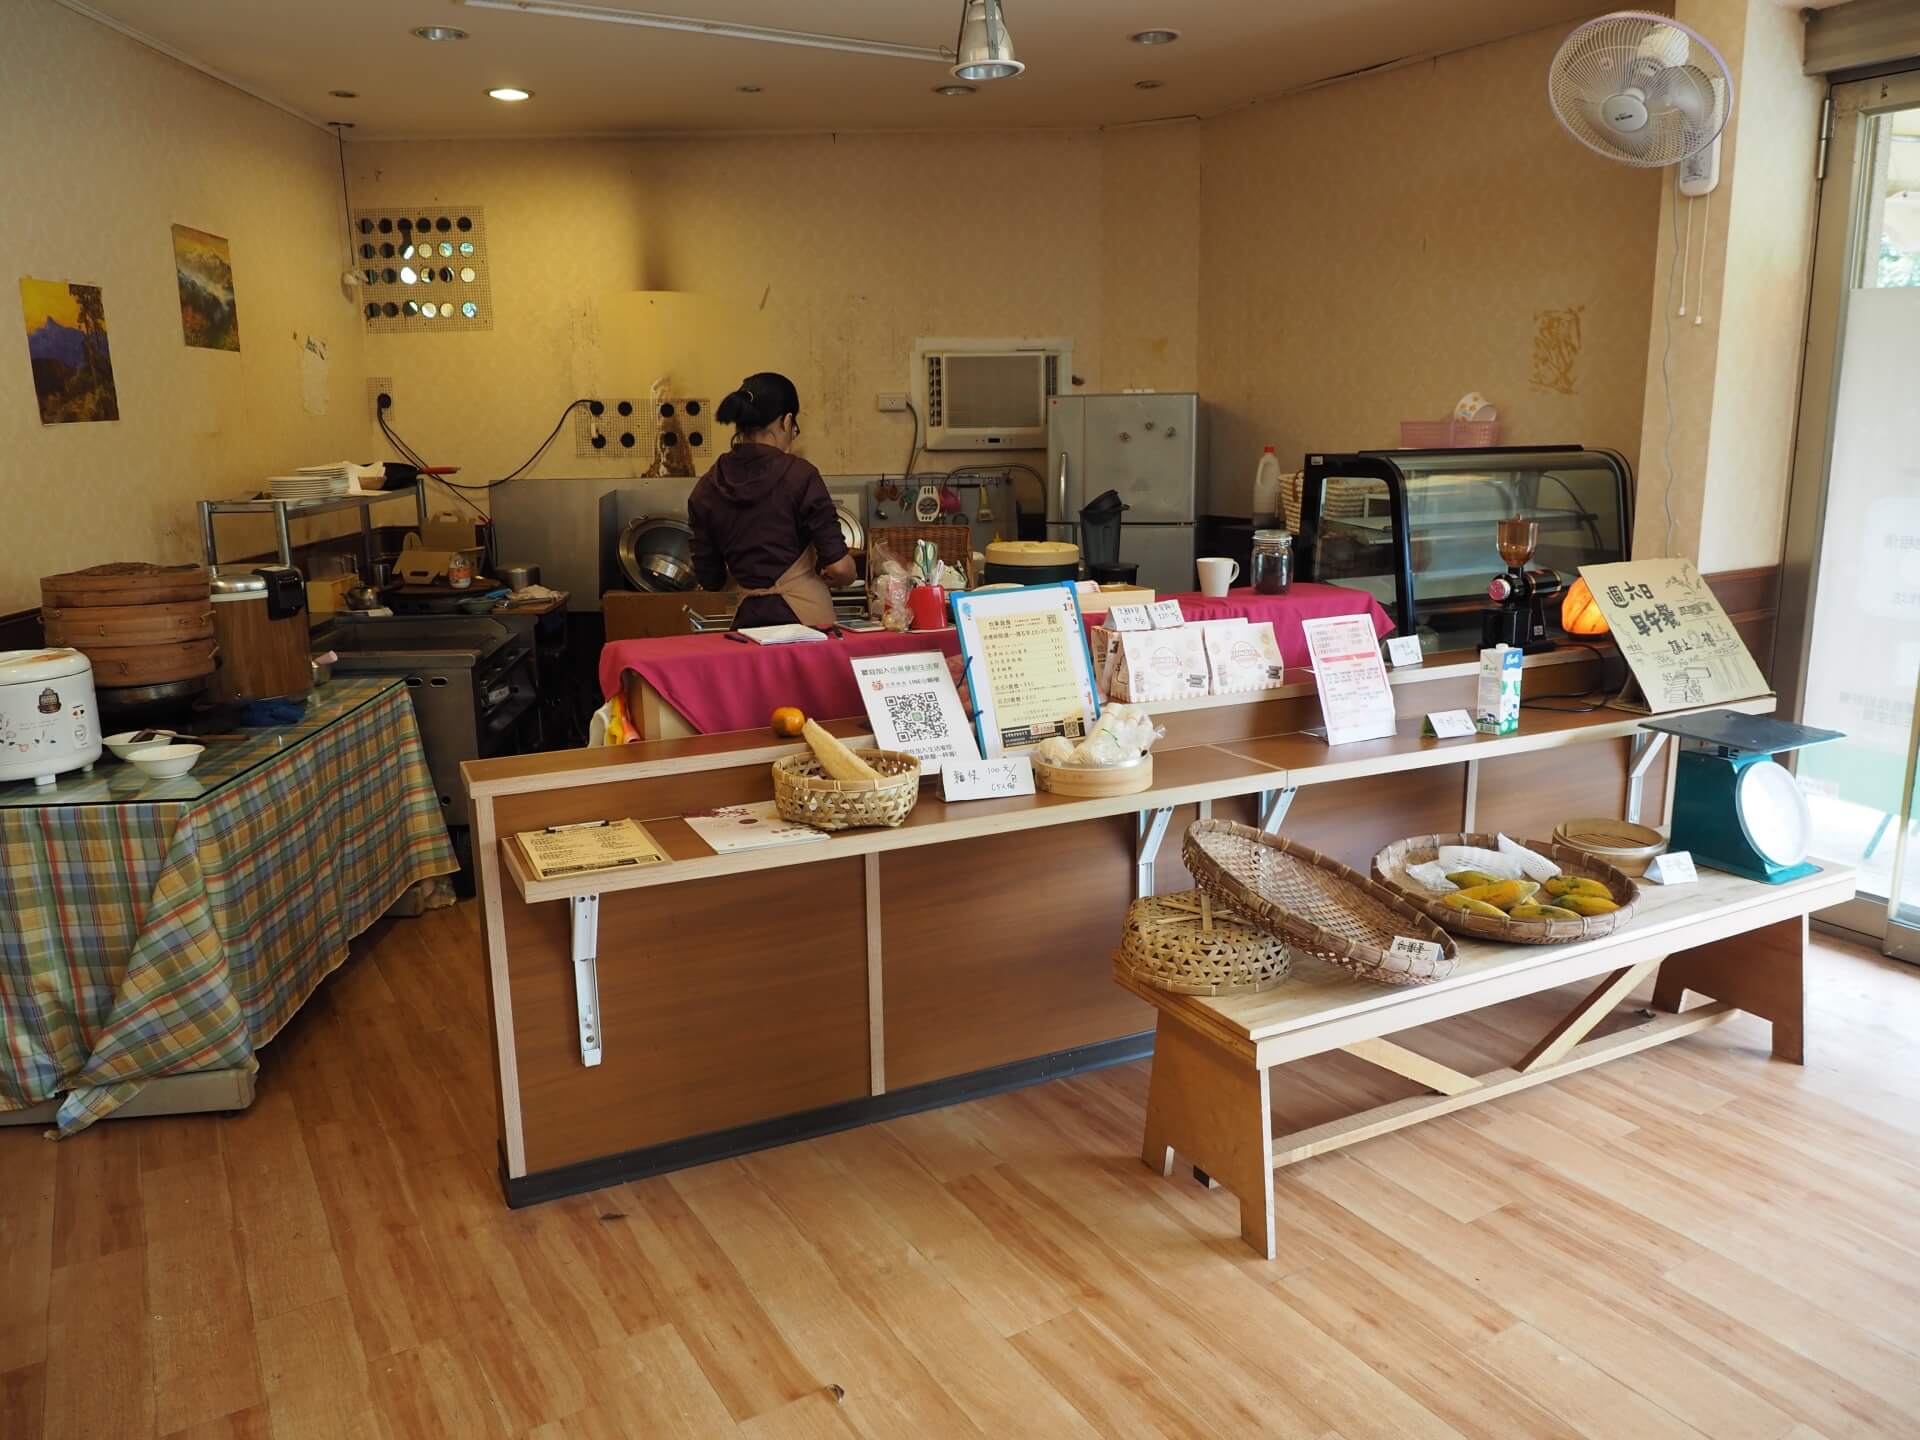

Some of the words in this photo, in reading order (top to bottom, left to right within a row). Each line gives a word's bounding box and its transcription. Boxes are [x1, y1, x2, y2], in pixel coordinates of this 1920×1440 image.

[1607, 581, 1654, 608] 週六日
[1630, 603, 1681, 637] 早午餐
